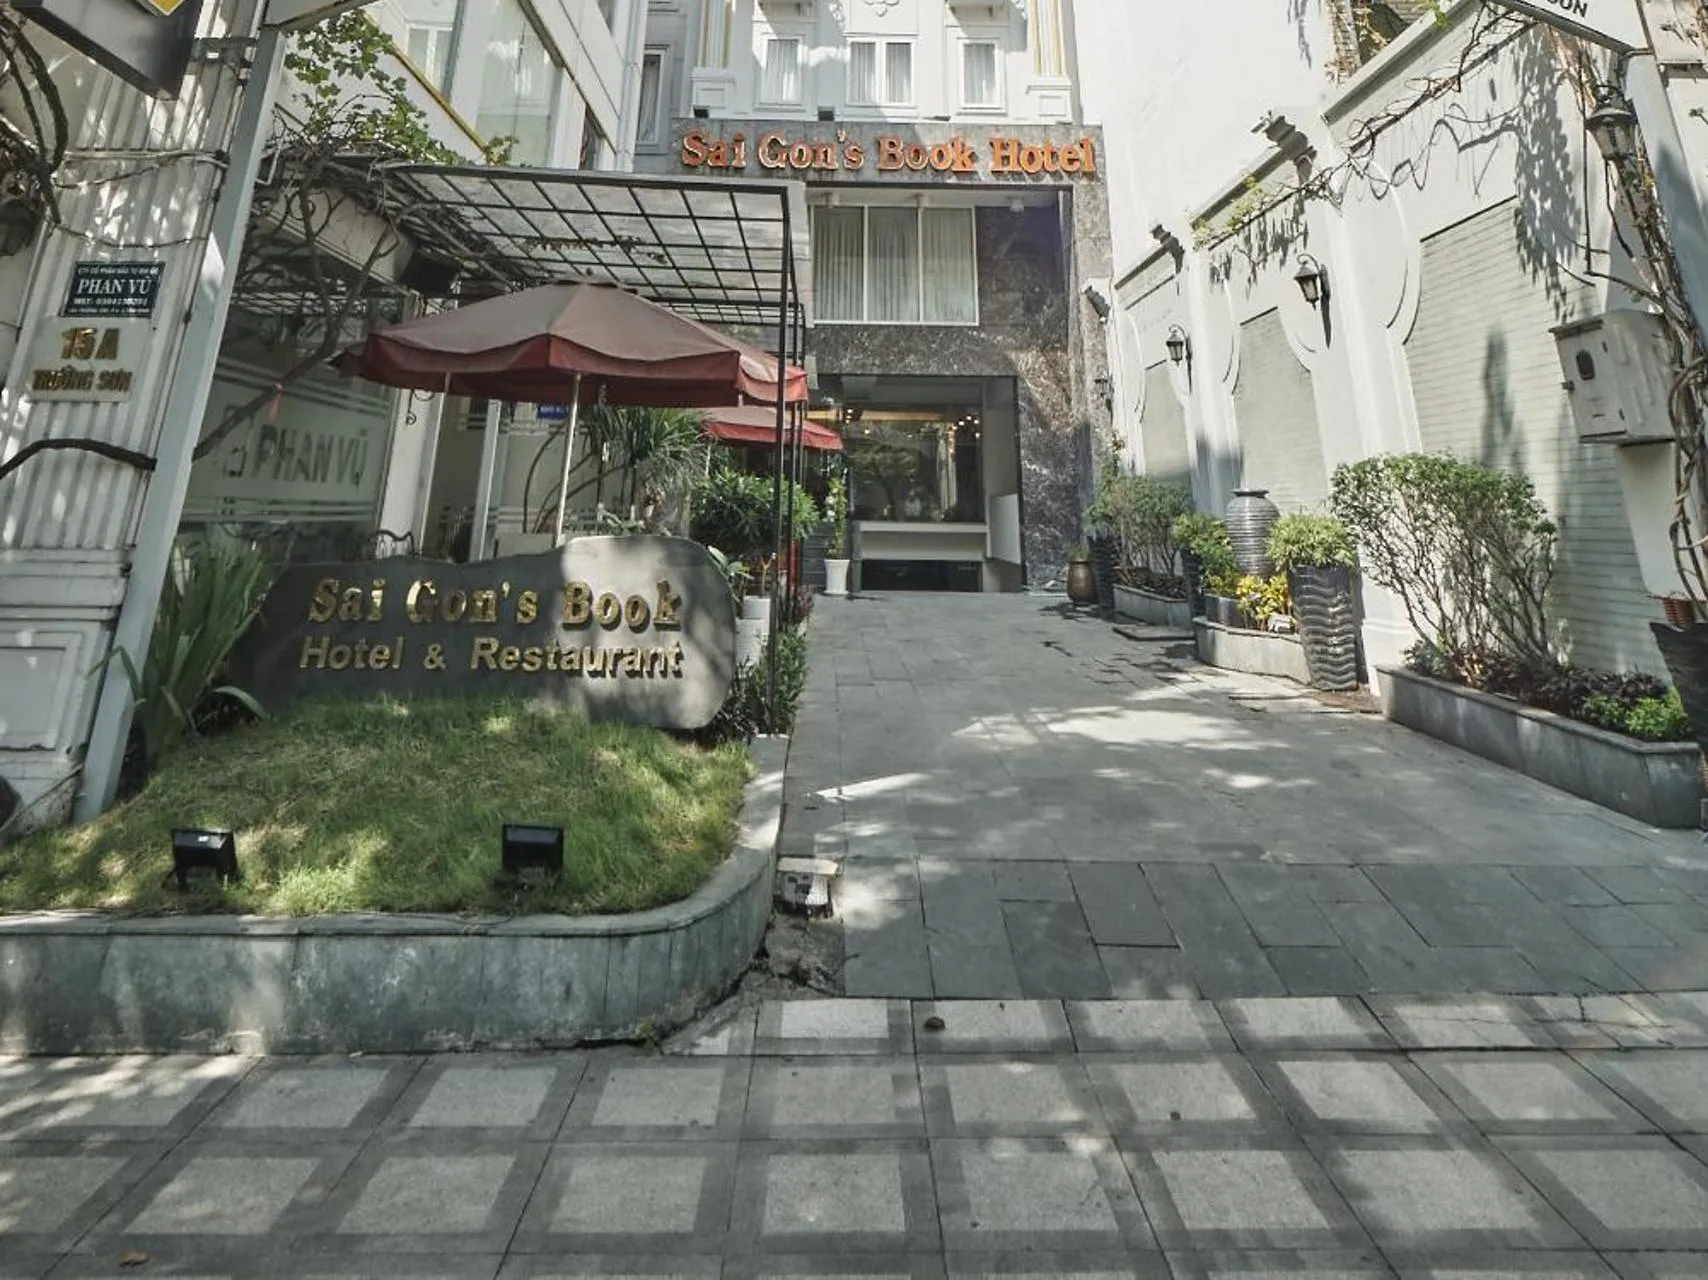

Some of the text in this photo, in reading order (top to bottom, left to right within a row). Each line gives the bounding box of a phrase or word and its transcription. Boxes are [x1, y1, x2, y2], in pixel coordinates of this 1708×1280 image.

[681, 128, 1096, 174] Sai Gon's Book Hotel
[77, 279, 126, 295] PHAN
[61, 327, 120, 361] 15A
[307, 577, 684, 629] Sai Gon's Book
[300, 636, 685, 677] Hotel & Restaurant
